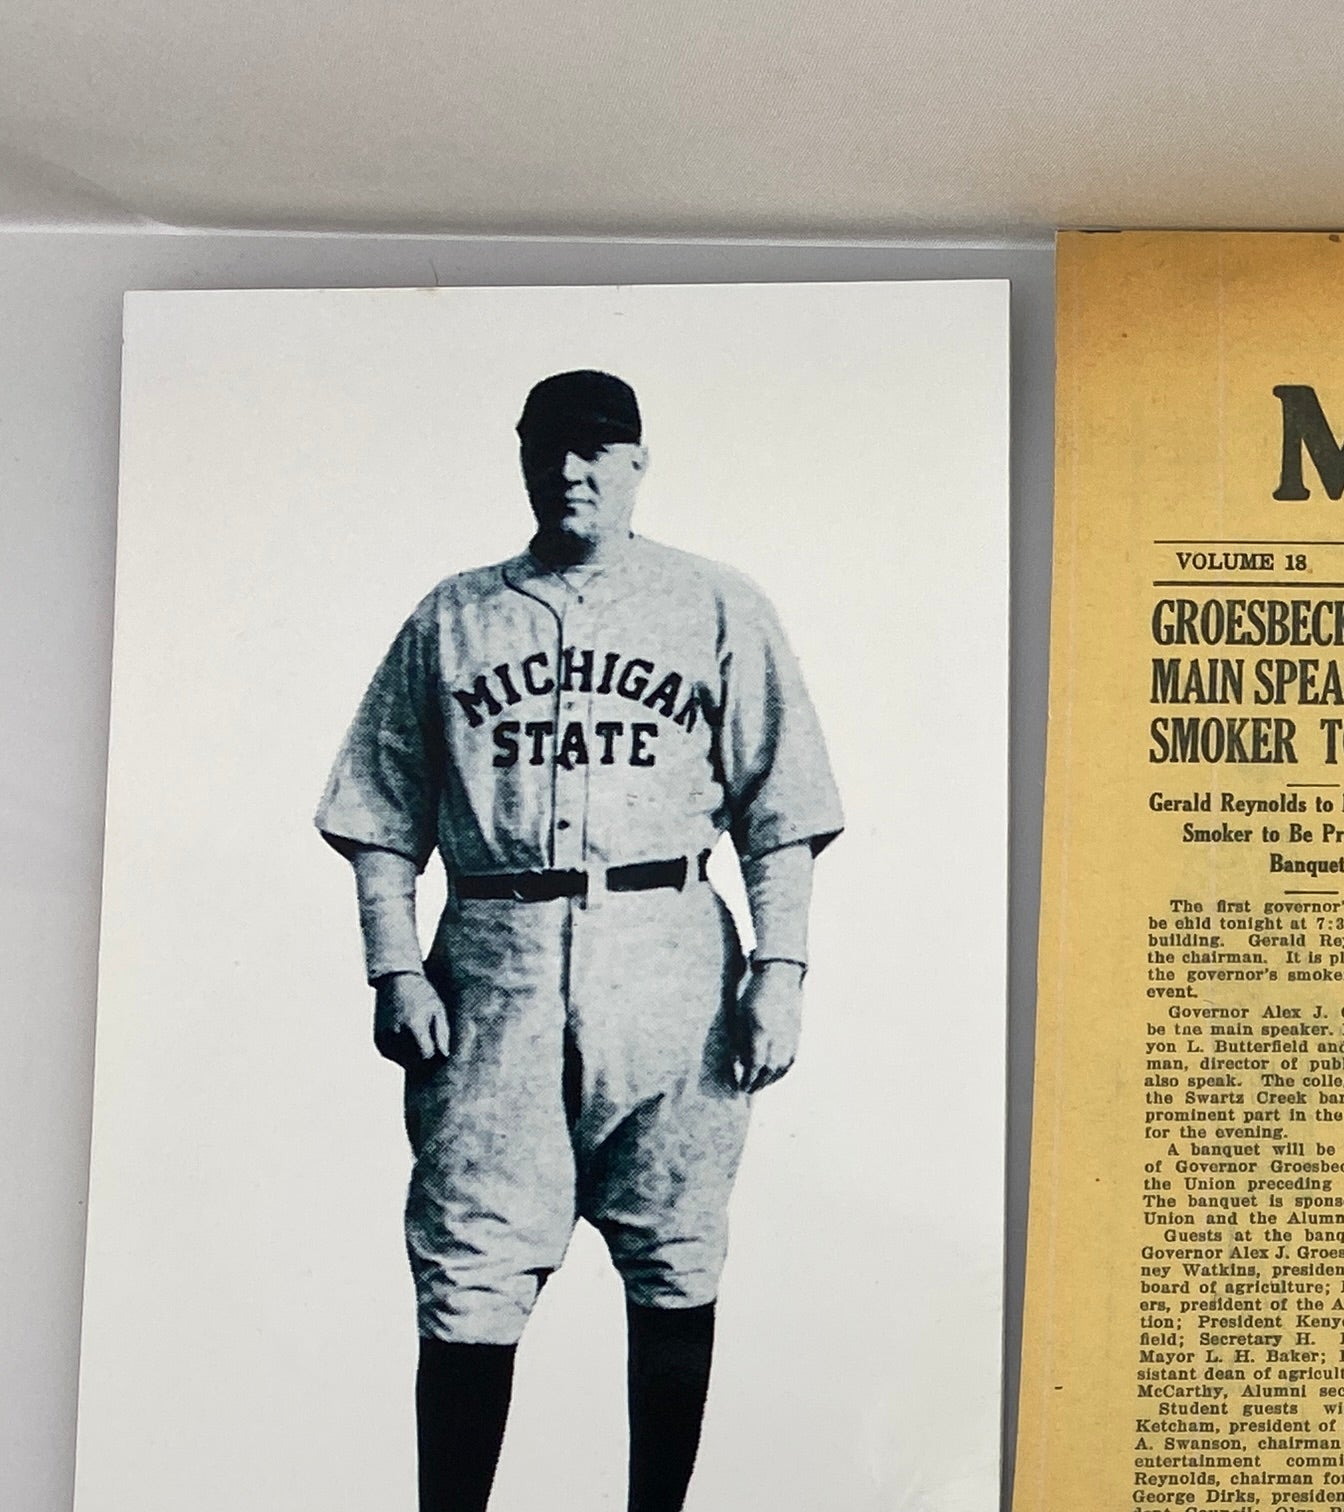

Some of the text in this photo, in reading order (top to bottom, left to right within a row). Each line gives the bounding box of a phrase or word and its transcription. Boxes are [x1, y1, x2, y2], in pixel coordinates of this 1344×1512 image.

[1175, 551, 1308, 572] VOLUME 18
[452, 646, 724, 740] MICHIGAN
[1149, 657, 1246, 706] MAIN
[492, 720, 659, 769] STATE
[1148, 716, 1299, 765] SMOKER
[1148, 791, 1212, 813] Gerald
[1219, 792, 1308, 817] Reynolds
[1315, 795, 1334, 813] to
[1182, 822, 1254, 843] Smoker
[1261, 825, 1281, 843] to
[1287, 822, 1314, 844] Be
[1169, 899, 1204, 914] The
[1216, 899, 1252, 914] first
